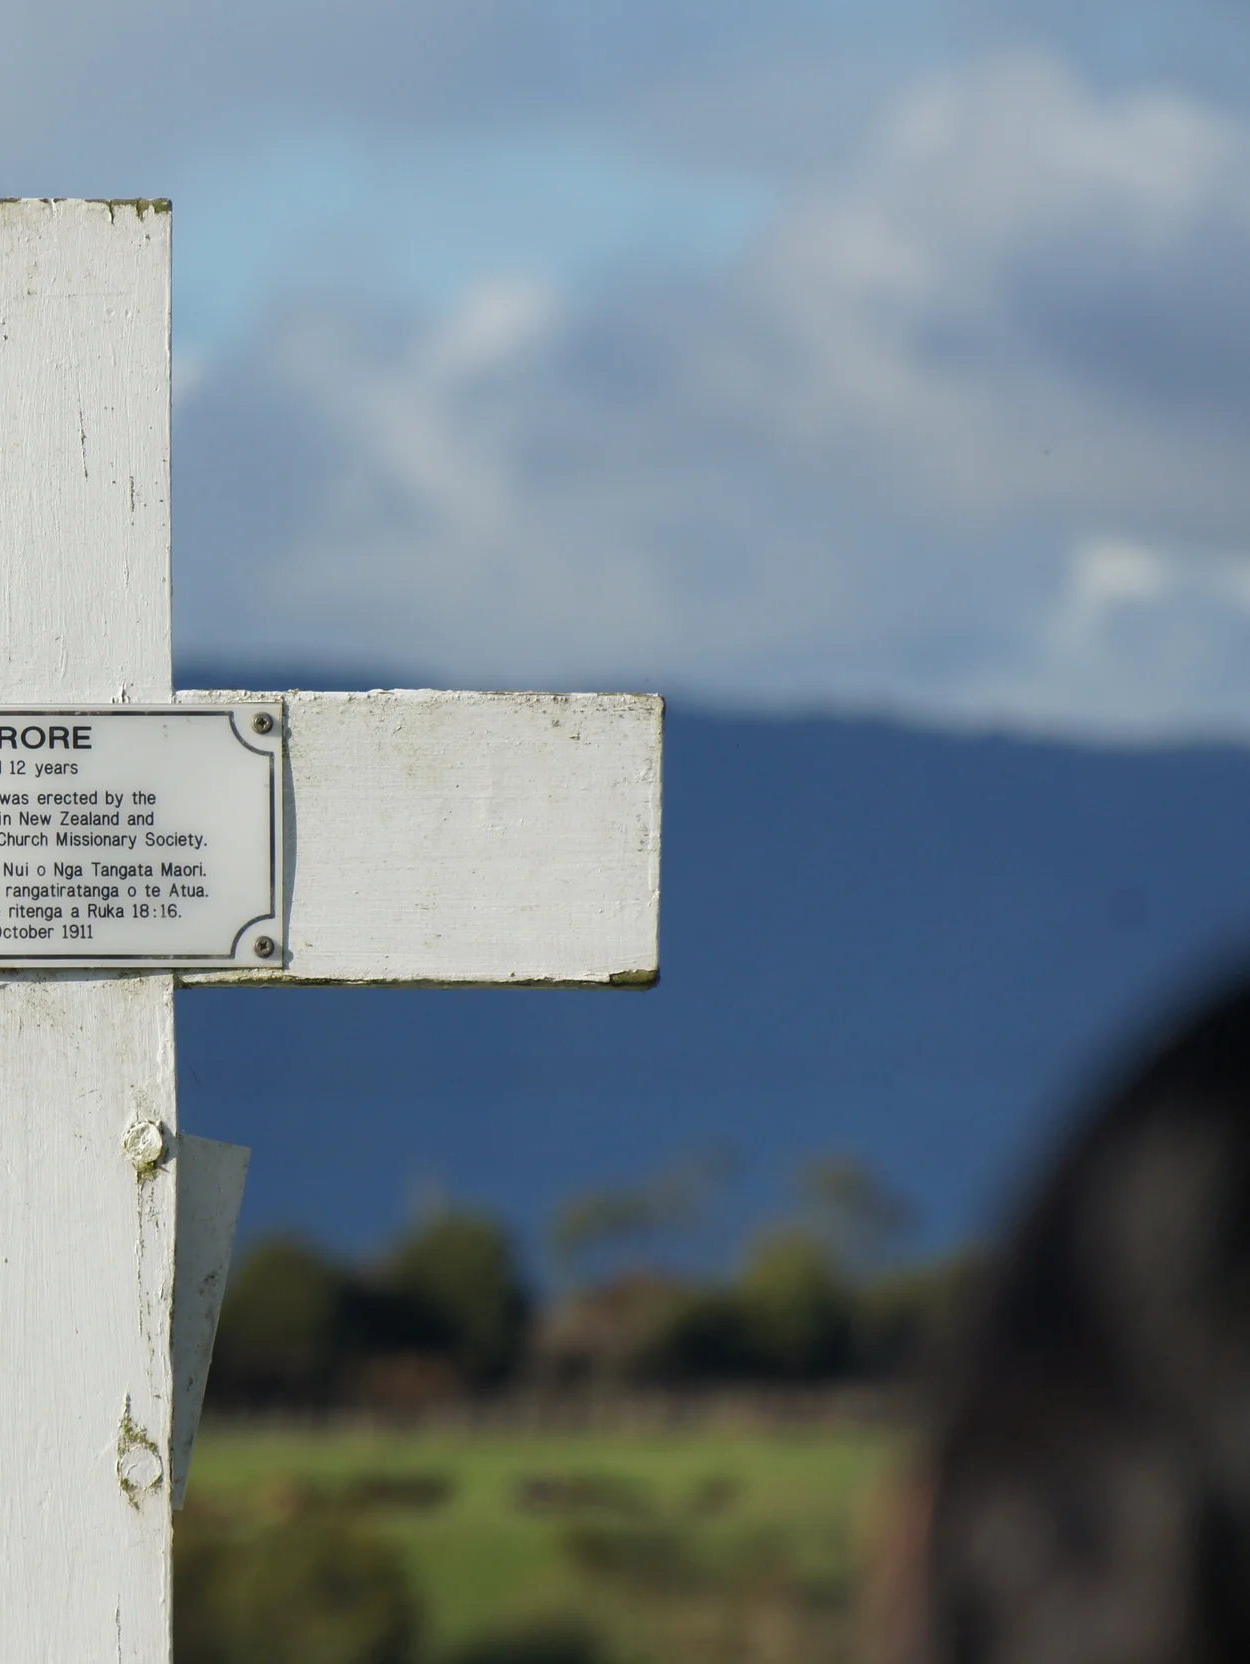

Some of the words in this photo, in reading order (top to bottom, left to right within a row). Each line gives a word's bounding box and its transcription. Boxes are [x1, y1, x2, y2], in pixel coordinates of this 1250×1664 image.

[9, 759, 27, 776] 12
[34, 762, 79, 779] years
[36, 790, 98, 806] erected
[105, 789, 124, 809] by
[131, 790, 157, 806] the
[19, 810, 52, 827] New
[59, 810, 120, 827] Zealand
[126, 810, 155, 827] and
[55, 831, 138, 851] Missionary
[144, 831, 208, 851] Society.
[3, 861, 29, 878] Nui
[36, 864, 47, 877] o
[53, 861, 84, 881] Nga
[90, 861, 154, 881] Tangata
[160, 861, 207, 878] Maori.
[5, 882, 120, 902] rangatiratanga
[126, 885, 137, 898] o
[144, 883, 161, 898] te
[168, 882, 209, 898] Atua.
[8, 903, 63, 922] ritenga
[70, 906, 81, 919] a
[87, 902, 125, 919] Ruka
[132, 902, 182, 919] 18:16.
[62, 923, 94, 940] 1911
